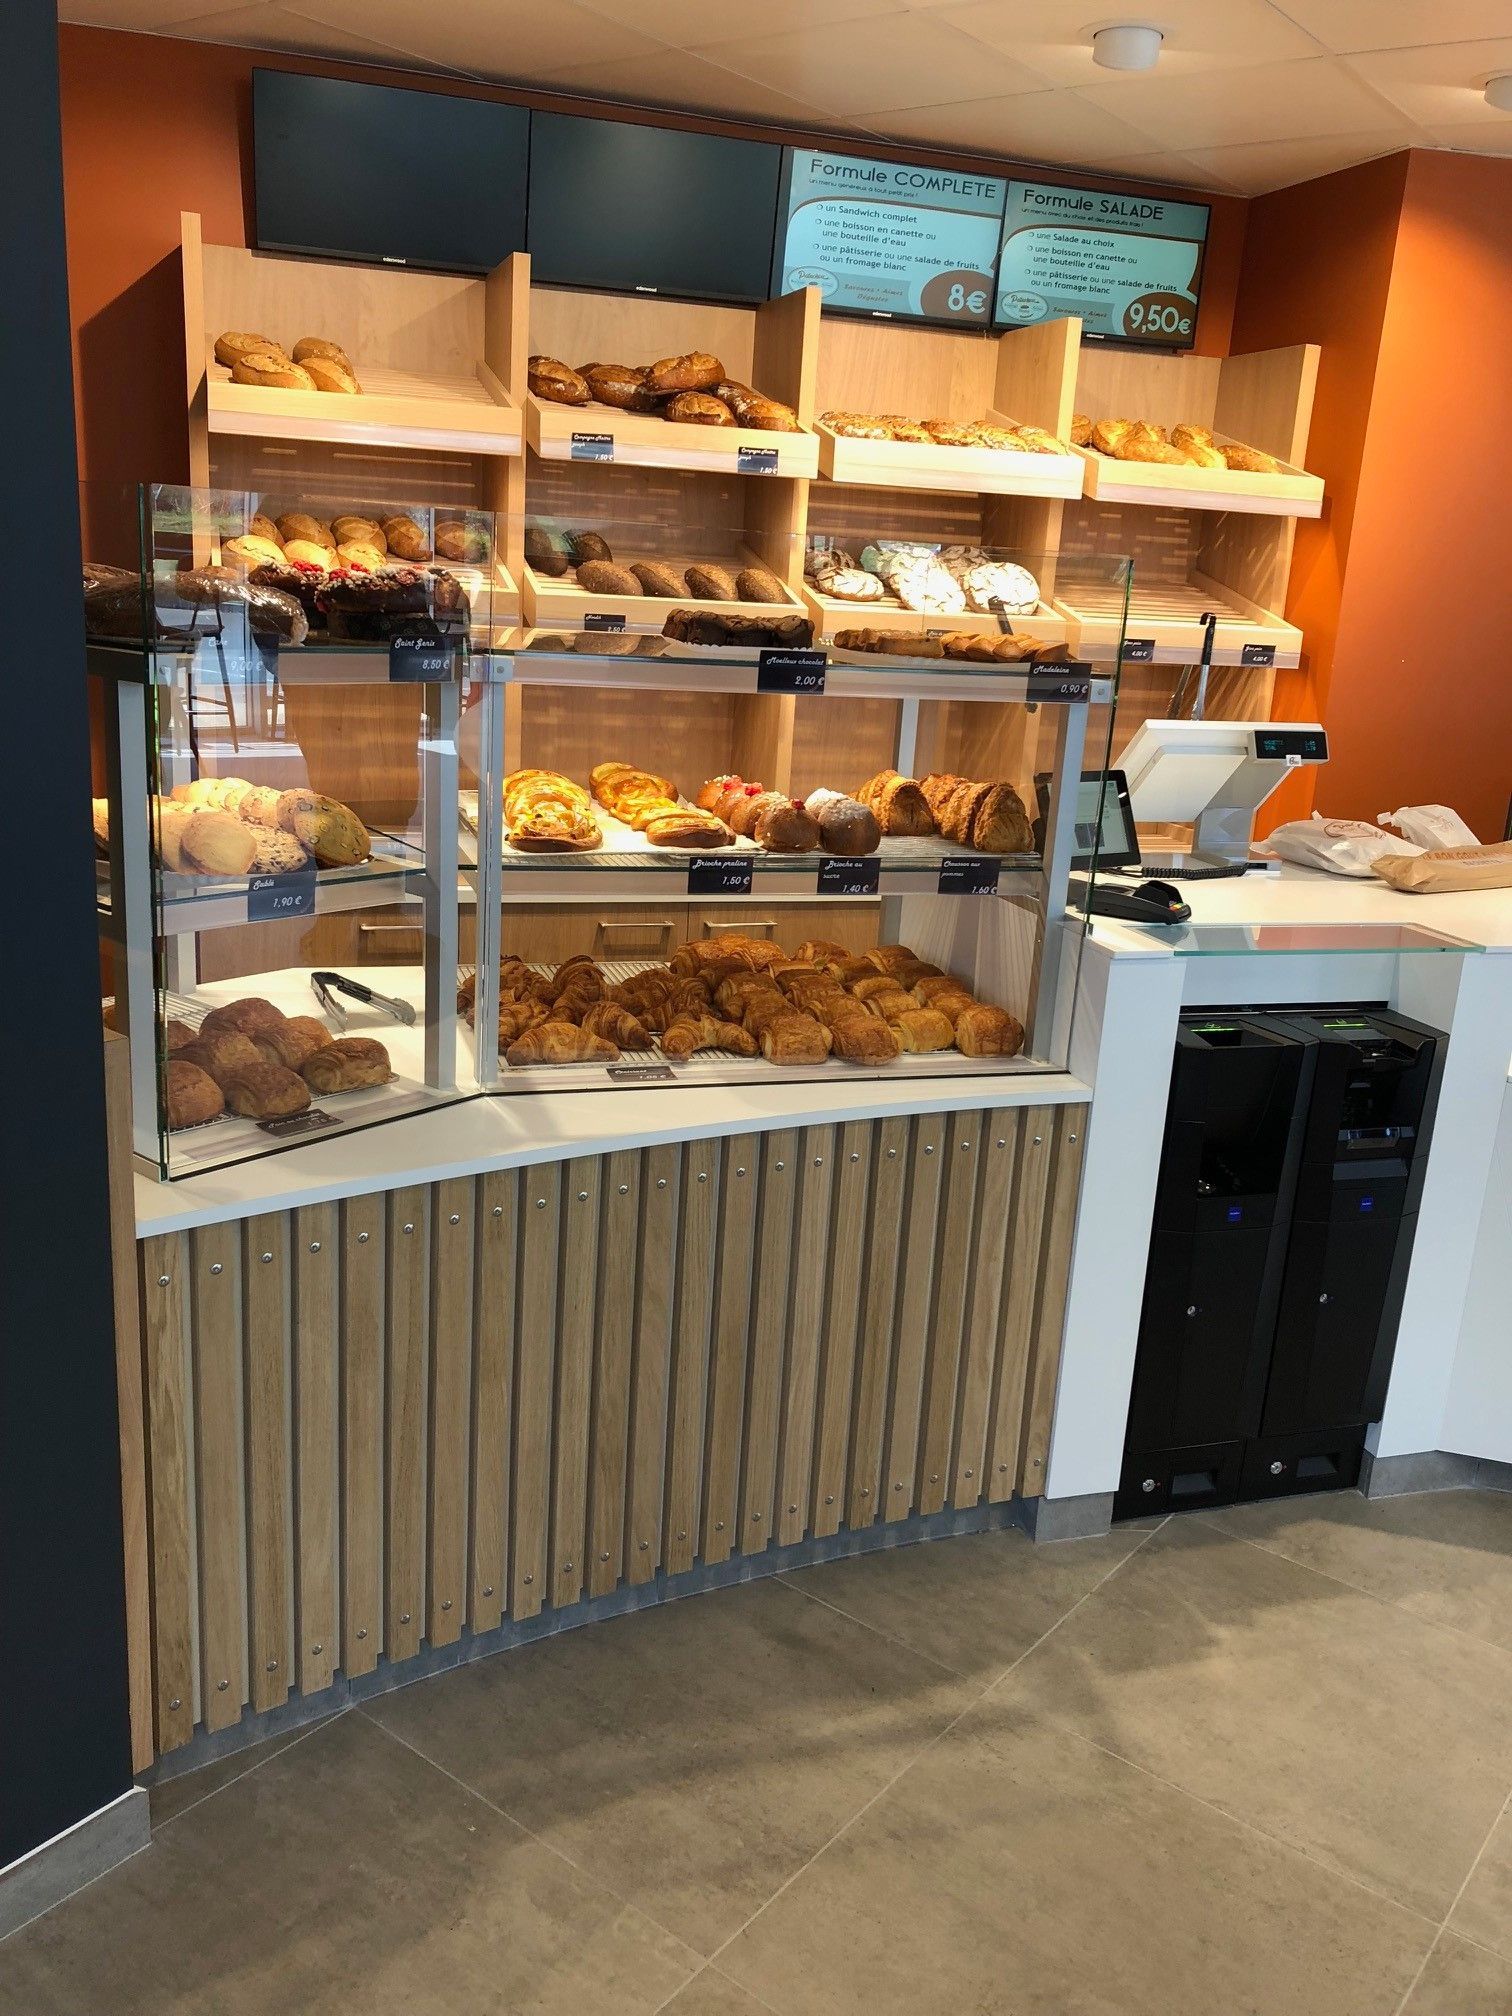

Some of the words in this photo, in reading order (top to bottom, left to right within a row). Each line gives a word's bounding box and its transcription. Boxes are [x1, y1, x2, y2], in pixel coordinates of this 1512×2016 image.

[810, 158, 888, 183] Formule
[894, 171, 997, 199] COMPLETE
[1023, 189, 1094, 211] Formule
[1099, 199, 1164, 221] SALADE
[839, 205, 880, 218] Sandwich
[882, 214, 918, 224] complet
[824, 220, 840, 228] une
[842, 220, 874, 232] boisson
[877, 226, 888, 234] en
[890, 228, 924, 239] canette
[822, 230, 838, 238] une
[840, 230, 880, 243] bouteille
[882, 237, 907, 247] d'eau
[1053, 233, 1079, 244] Salade
[1093, 239, 1115, 248] choix
[822, 244, 838, 252] une
[840, 246, 882, 258] pâtisserie
[884, 252, 895, 260] ou
[896, 254, 912, 262] une
[914, 256, 942, 266] salade
[944, 259, 954, 267] de
[956, 260, 979, 270] fruits
[1034, 246, 1050, 254] une
[1052, 247, 1082, 258] boisson
[1095, 252, 1126, 262] canette
[819, 254, 830, 262] ou
[832, 256, 844, 264] un
[846, 256, 882, 269] fromage
[884, 261, 906, 272] blanc
[1032, 256, 1048, 264] une
[1050, 256, 1086, 268] bouteille
[1088, 262, 1110, 271] d'eau
[1032, 269, 1048, 277] une
[1049, 270, 1088, 282] pâtisserie
[1117, 279, 1142, 289] salade
[1144, 282, 1154, 290] de
[1156, 283, 1178, 292] fruits
[1042, 280, 1052, 288] un
[1054, 281, 1088, 292] fromage
[1089, 284, 1110, 294] blanc
[947, 283, 988, 314] 8€
[1129, 302, 1192, 335] 9,50€
[394, 637, 415, 648] Saint
[422, 659, 442, 670] 8,50
[443, 659, 450, 670] €
[798, 658, 824, 666] chocolat
[1033, 665, 1070, 674] Madeleine
[794, 676, 816, 686] 2,00
[818, 676, 825, 686] €
[1060, 684, 1080, 694] 0,90
[1081, 684, 1088, 694] €
[692, 860, 722, 870] Brioche
[722, 860, 748, 869] praline
[824, 860, 853, 870] Brioche
[722, 876, 742, 886] 1,50
[742, 876, 750, 885] €
[842, 884, 861, 893] 1,40
[862, 884, 869, 892] €
[990, 886, 998, 894] €
[273, 896, 294, 908] 1,90
[294, 895, 302, 905] €
